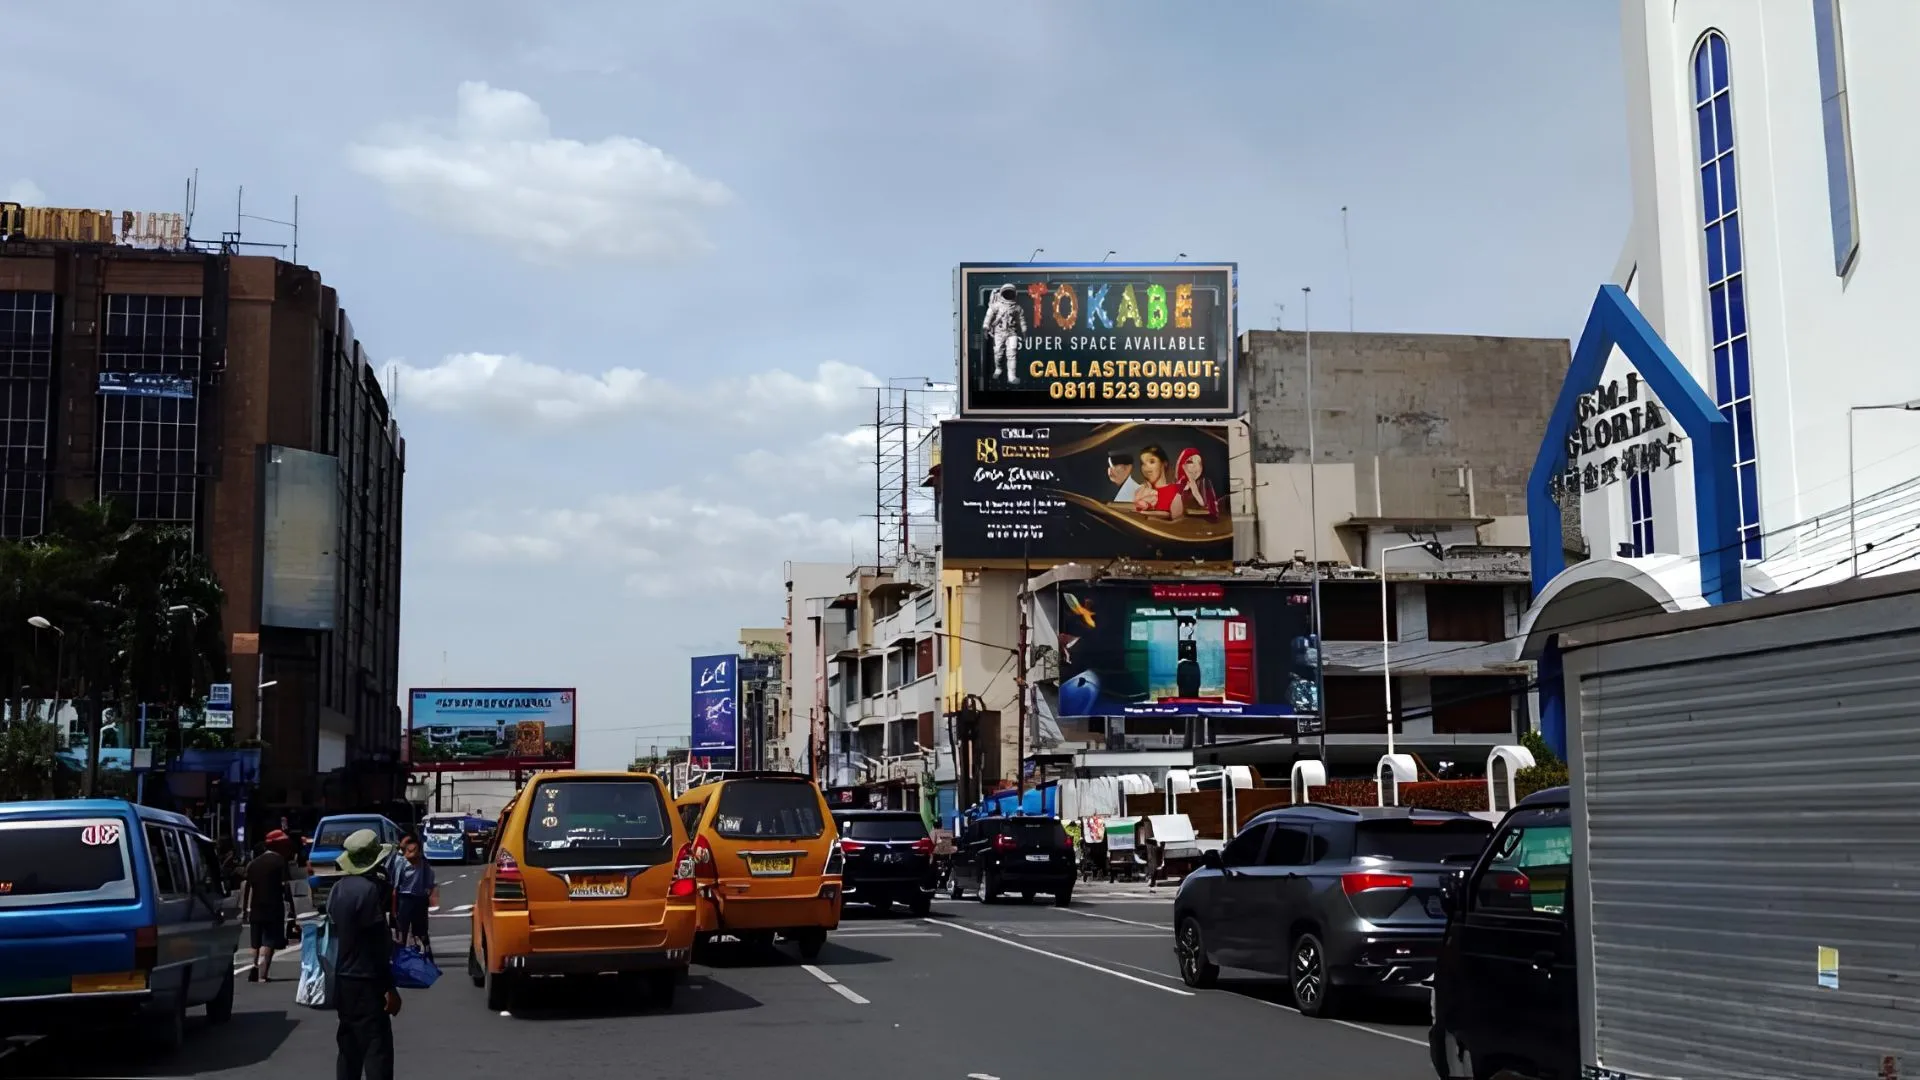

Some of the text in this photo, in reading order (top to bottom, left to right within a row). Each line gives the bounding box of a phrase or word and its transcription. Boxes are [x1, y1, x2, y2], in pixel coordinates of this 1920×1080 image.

[1015, 336, 1206, 350] SUPER SPACE AVAILABLE
[1029, 360, 1221, 378] CALL ASTRONAUT:
[1050, 381, 1201, 399] 0811 523 9999
